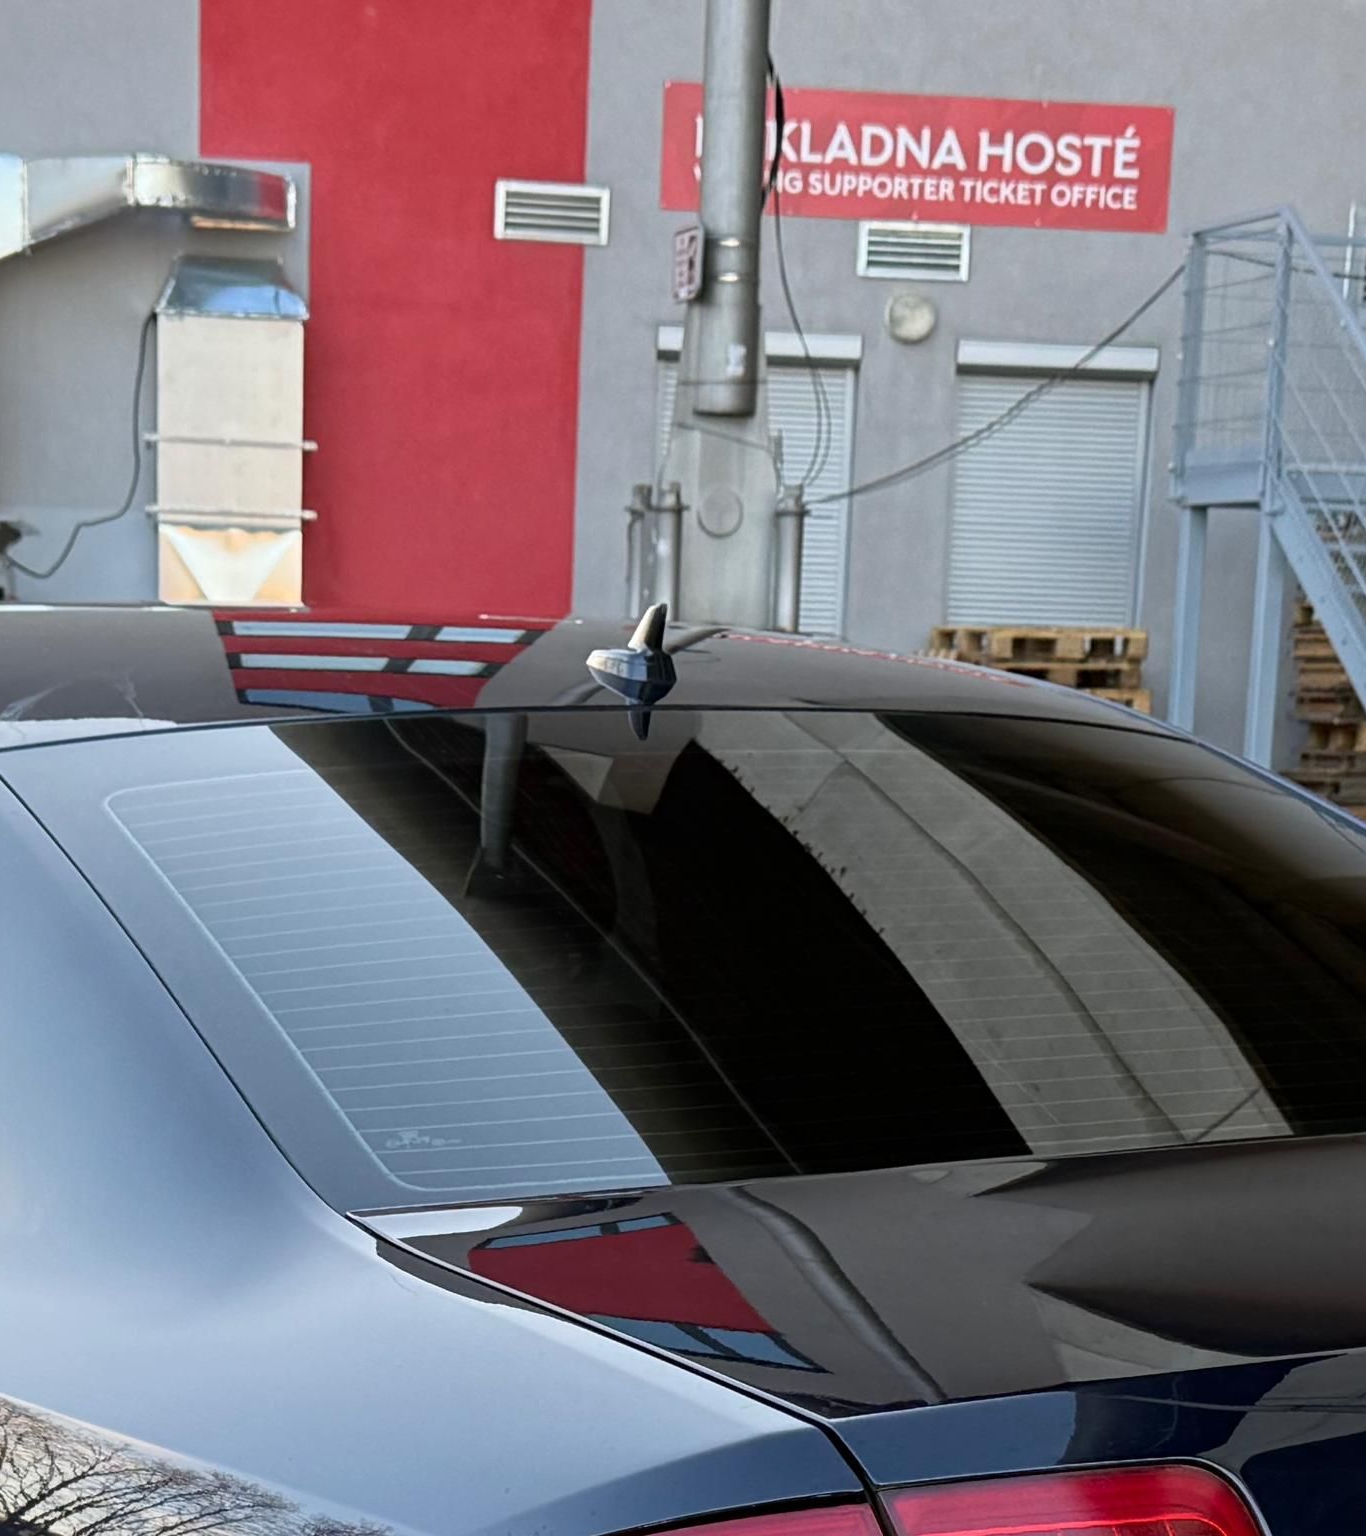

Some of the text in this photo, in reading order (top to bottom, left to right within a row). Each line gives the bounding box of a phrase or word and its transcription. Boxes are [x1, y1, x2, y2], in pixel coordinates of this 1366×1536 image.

[695, 112, 1141, 179] KLADNA HOSTÉ
[808, 169, 955, 201] SUPPORTER
[959, 177, 1047, 207] TICKET
[1050, 181, 1138, 210] OFFICE
